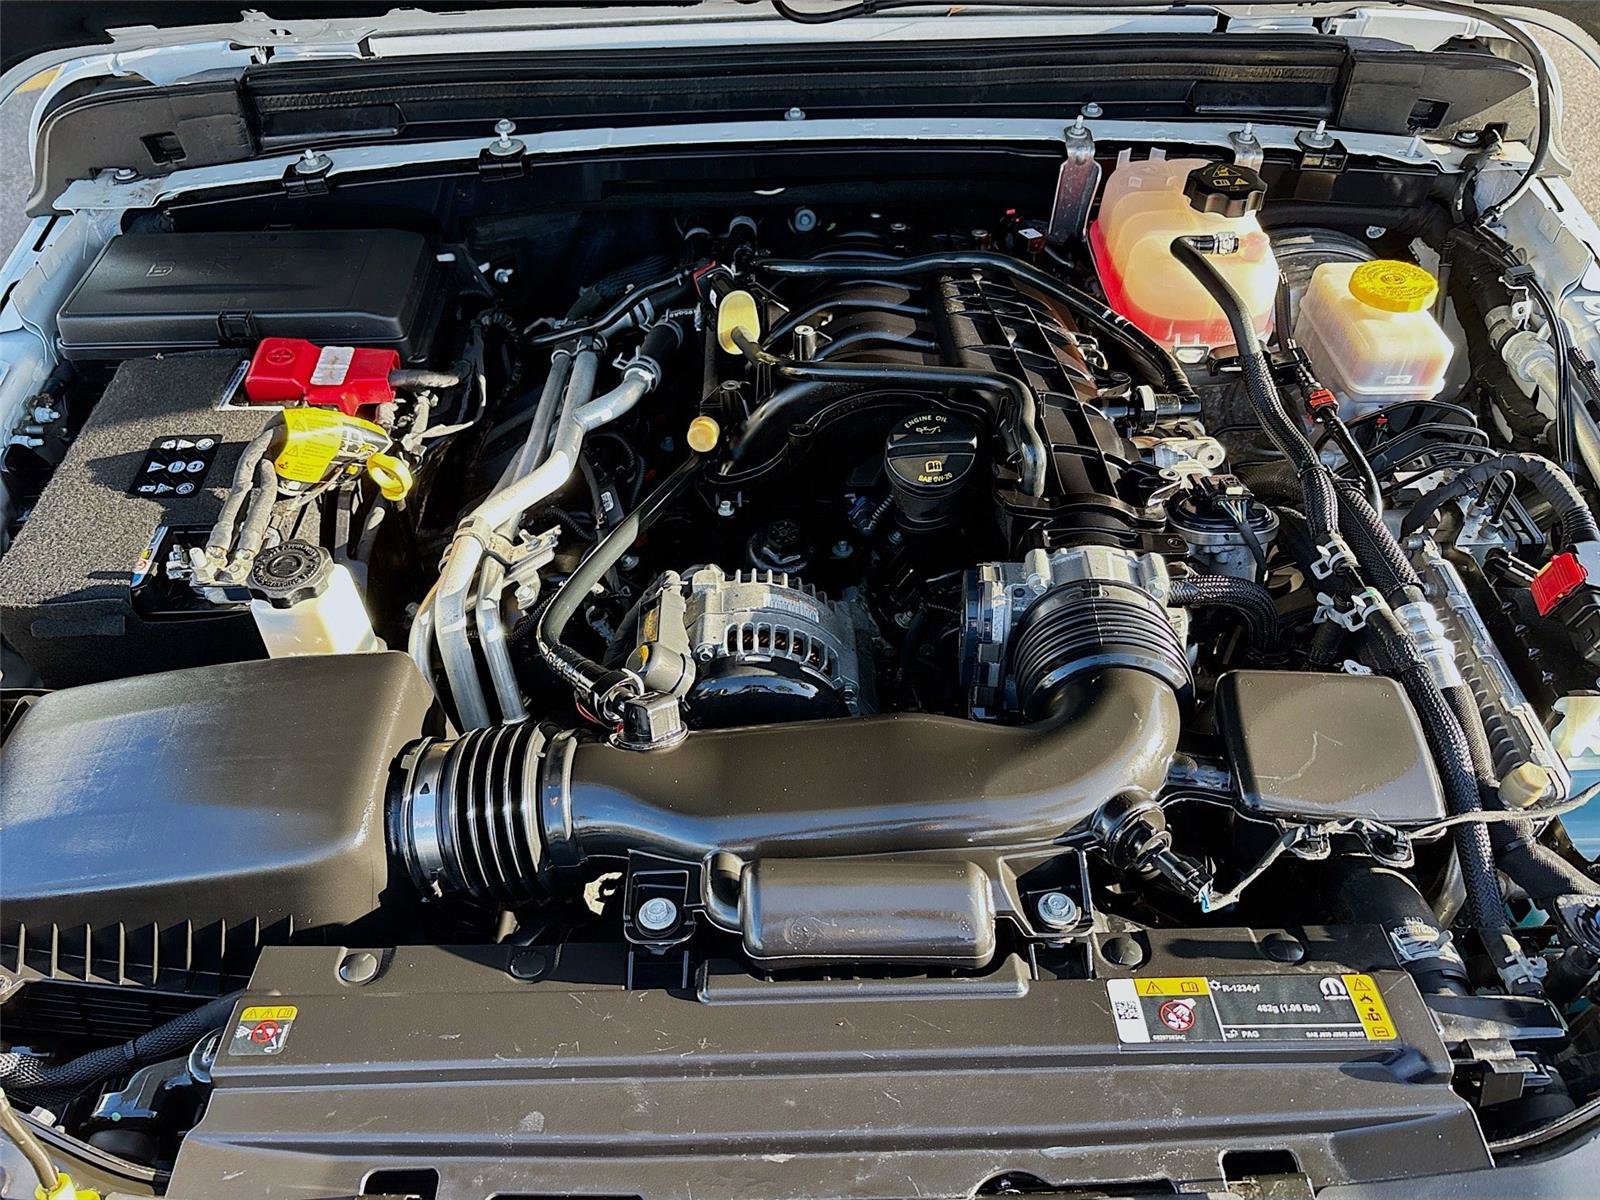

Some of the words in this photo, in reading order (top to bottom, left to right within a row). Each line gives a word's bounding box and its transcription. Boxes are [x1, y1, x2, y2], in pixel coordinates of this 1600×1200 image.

[904, 415, 932, 429] ENGINE
[935, 415, 948, 423] OIL
[1222, 983, 1260, 993] R-1234yf
[1302, 1003, 1321, 1013] lbs)
[1241, 1030, 1260, 1038] PAG
